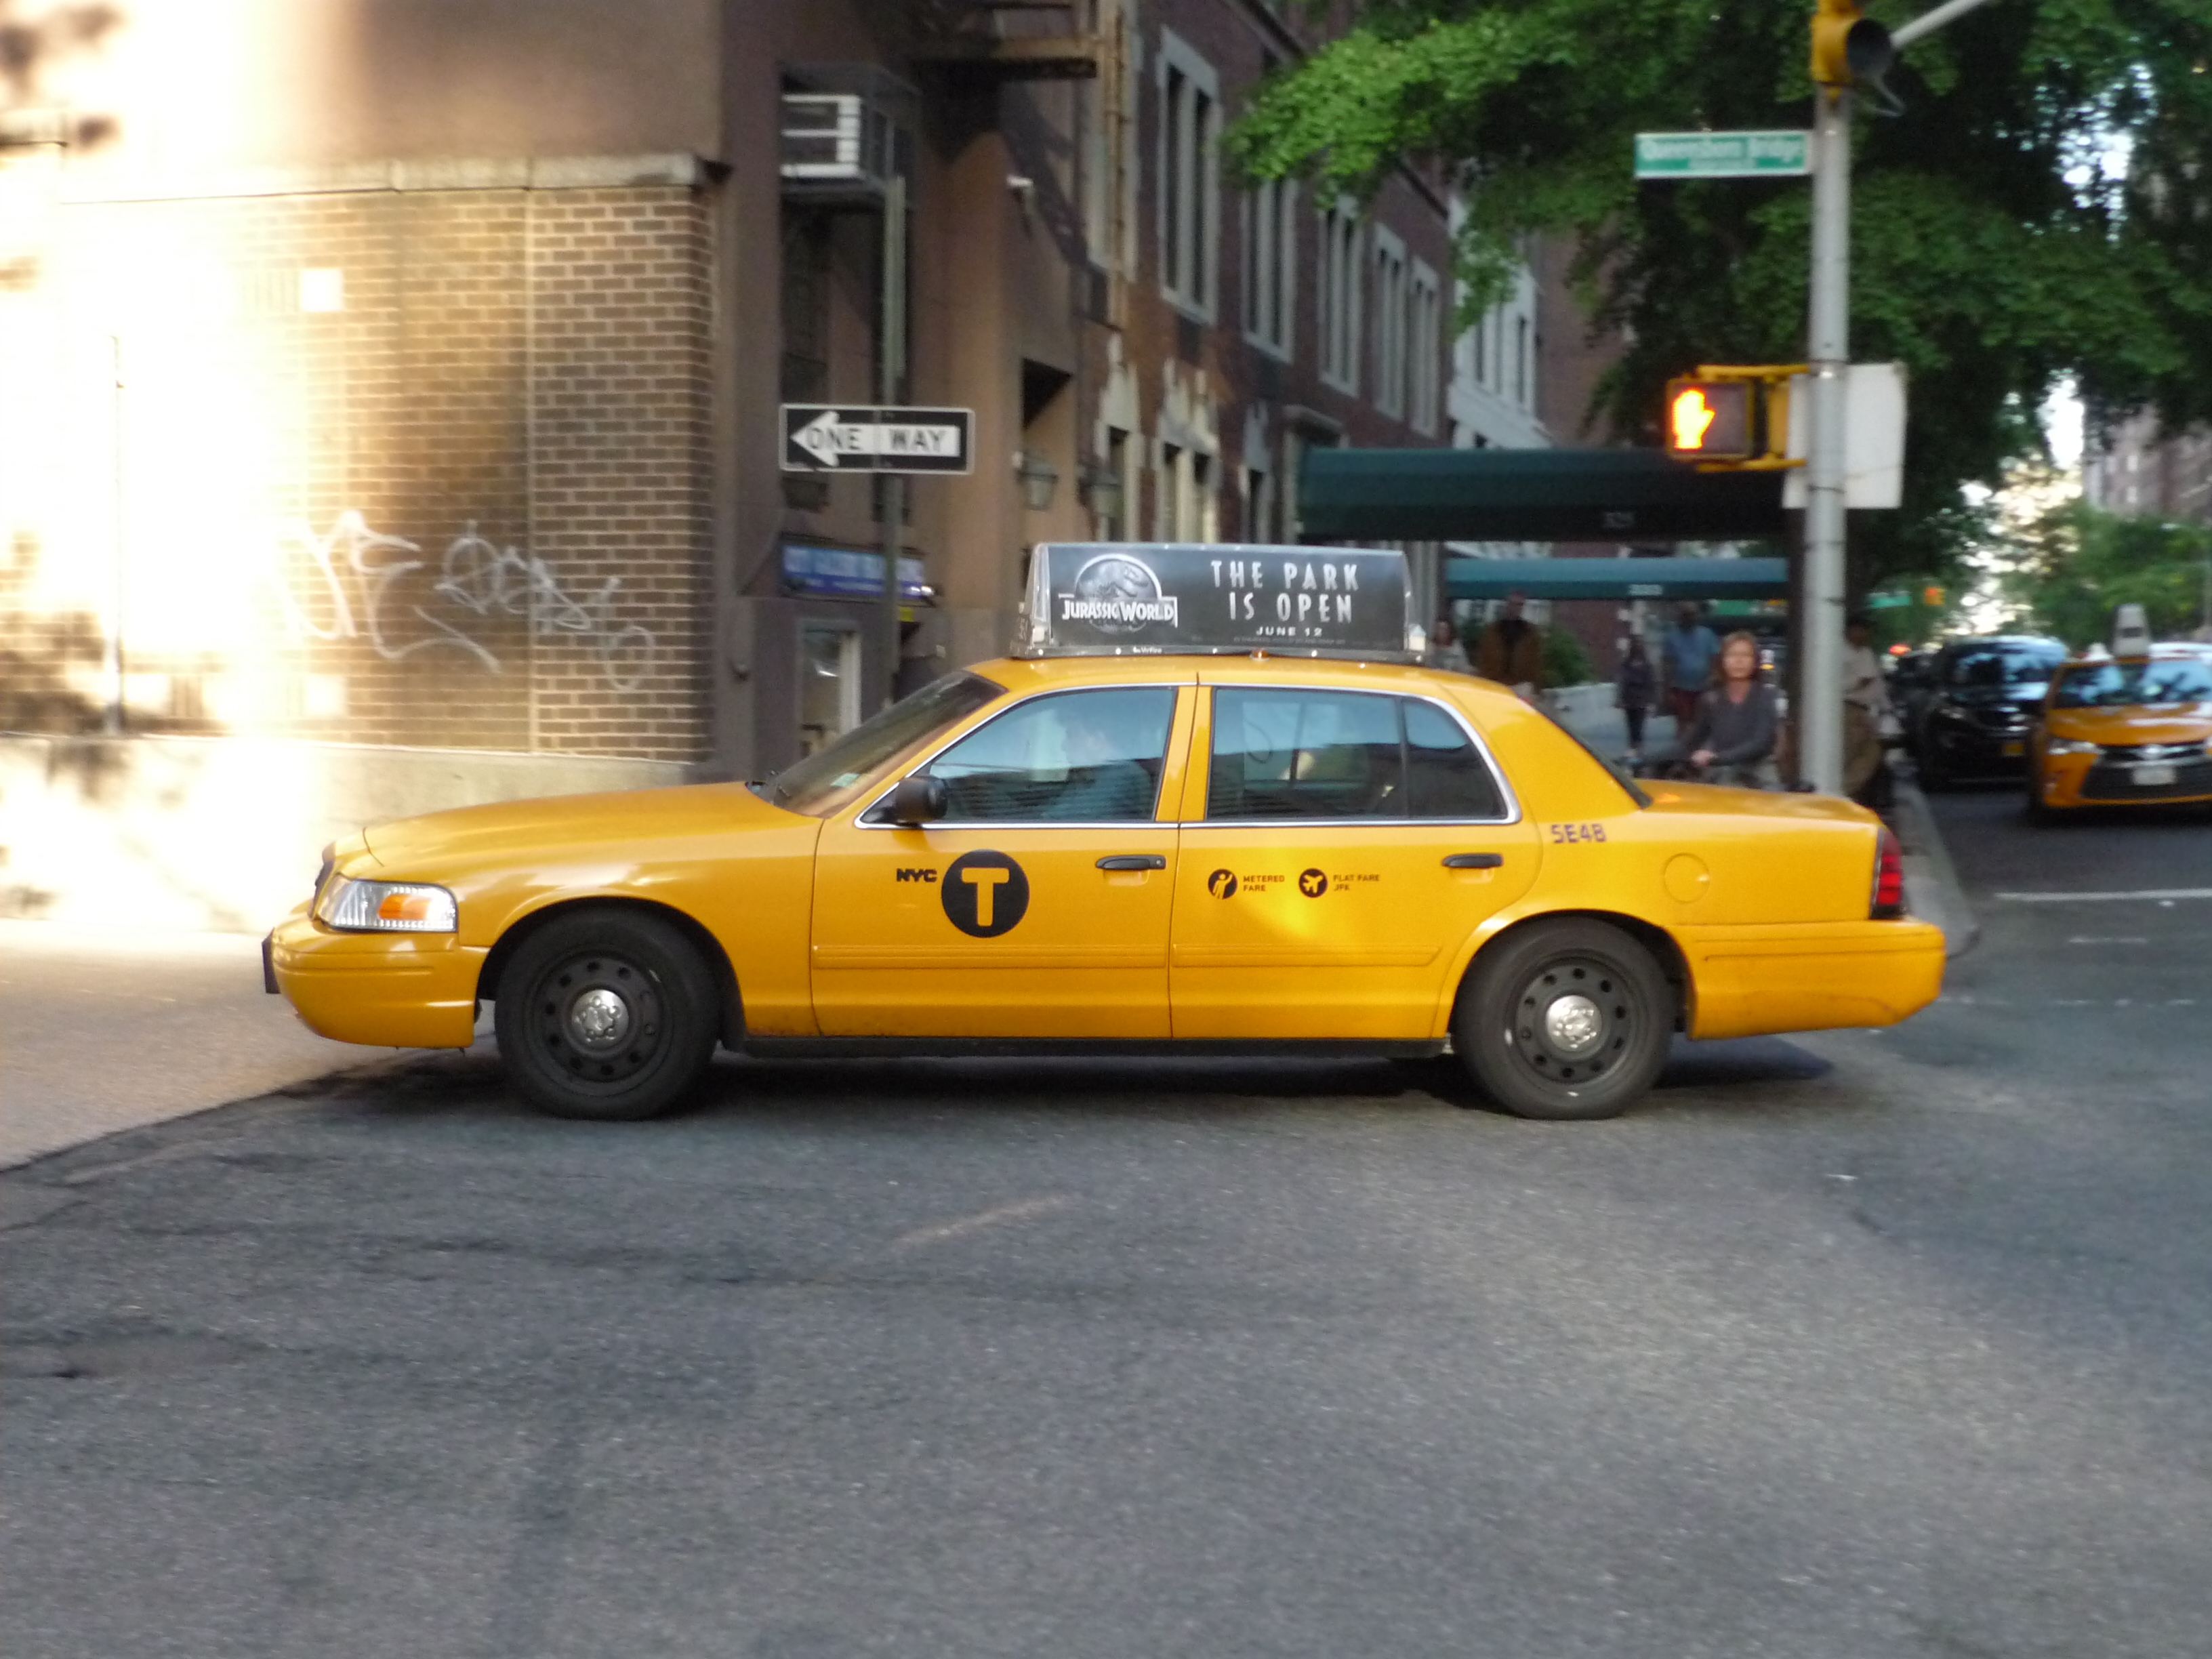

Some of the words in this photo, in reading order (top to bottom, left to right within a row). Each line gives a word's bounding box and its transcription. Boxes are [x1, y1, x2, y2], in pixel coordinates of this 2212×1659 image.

[806, 428, 861, 450] ONE
[889, 429, 947, 452] WAY
[1210, 559, 1263, 588] THE
[1284, 562, 1359, 591] PARK
[1061, 599, 1119, 621] JURASSIC
[1119, 600, 1174, 622] WORLD
[1228, 592, 1254, 621] IS
[1276, 593, 1352, 623] OPEN
[1256, 626, 1296, 636] JUNE
[1305, 627, 1323, 637] 12
[896, 867, 937, 882] NYC
[1243, 875, 1285, 883] METERED
[1333, 874, 1355, 882] FLAT
[1357, 874, 1380, 882] FARE
[961, 867, 1010, 927] T
